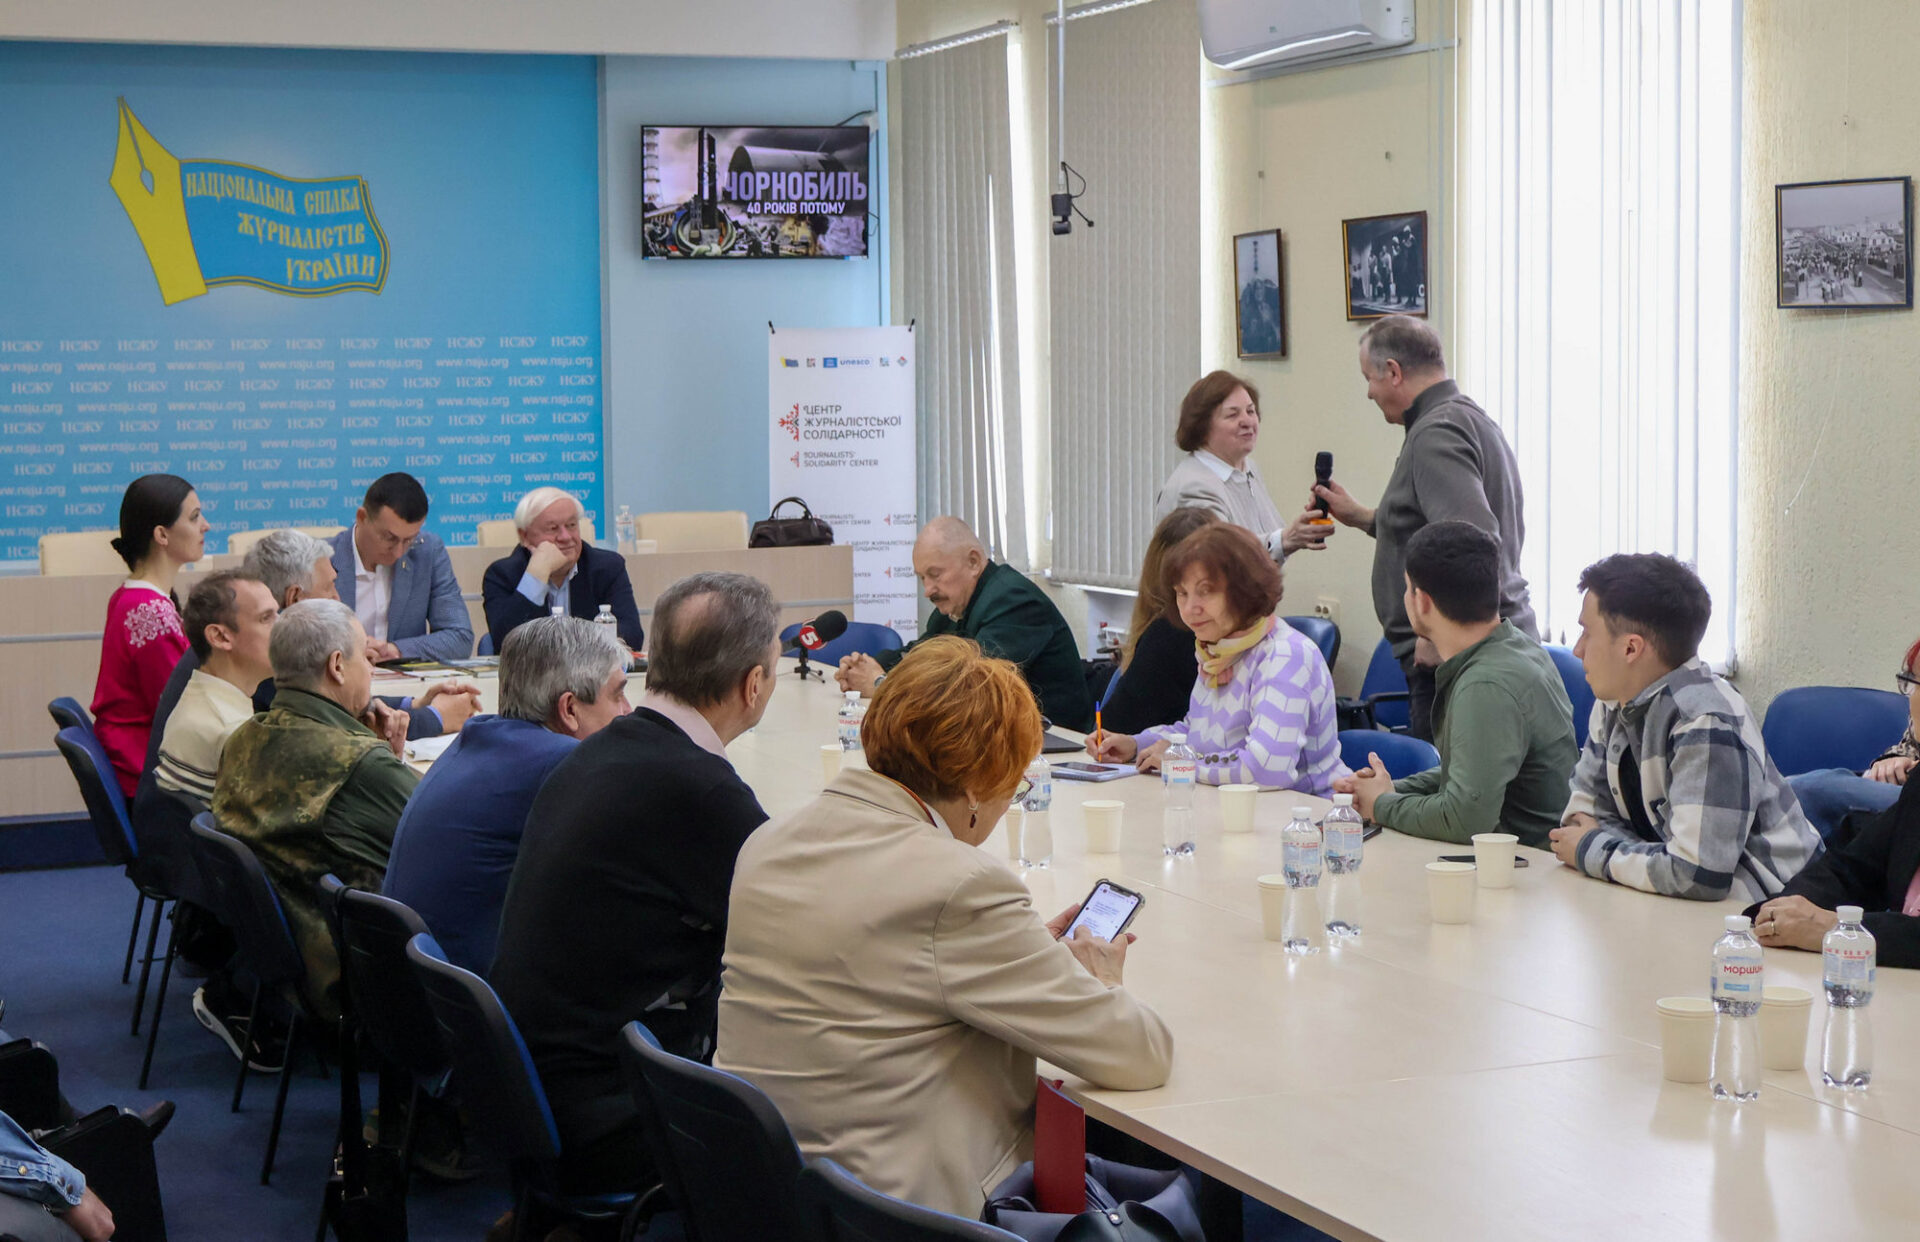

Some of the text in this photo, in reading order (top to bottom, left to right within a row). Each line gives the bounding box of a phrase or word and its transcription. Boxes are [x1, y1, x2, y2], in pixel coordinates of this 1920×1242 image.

[185, 171, 361, 216] НАЦІОНАЛЬНА СПІЛКА
[725, 171, 867, 201] ЧОРНОБИЛЬ
[747, 202, 845, 214] 40 РОКІВ ПОТОМУ
[238, 211, 365, 249] ЖУРНАЛІСТІВ
[286, 252, 376, 285] УКРАЇНИ
[76, 361, 156, 373] www.nsju.org
[166, 360, 246, 372] www.nsju.org
[259, 359, 336, 370] www.nsju.org
[348, 358, 423, 370] www.nsju.org
[436, 357, 510, 369] www.nsju.org
[521, 356, 594, 368] www.nsju.org
[840, 358, 870, 366] unesco
[77, 402, 158, 413] www.nsju.org
[167, 401, 246, 412] www.nsju.org
[259, 399, 336, 411] www.nsju.org
[349, 398, 424, 409] www.nsju.org
[436, 396, 510, 408] www.nsju.org
[522, 394, 595, 406] www.nsju.org
[803, 405, 842, 416] ЦЕНТР
[804, 415, 902, 428] ЖУРНАЛІСТСЬКОЇ
[79, 441, 159, 453] www.nsju.org
[169, 440, 247, 451] www.nsju.org
[261, 438, 337, 450] www.nsju.org
[351, 436, 425, 448] www.nsju.org
[437, 434, 511, 446] www.nsju.org
[523, 432, 595, 444] www.nsju.org
[803, 429, 885, 441] СОЛІДАРНОСТІ
[261, 478, 338, 490] www.nsju.org
[438, 474, 512, 486] www.nsju.org
[524, 471, 596, 483] www.nsju.org
[801, 631, 819, 646] 5
